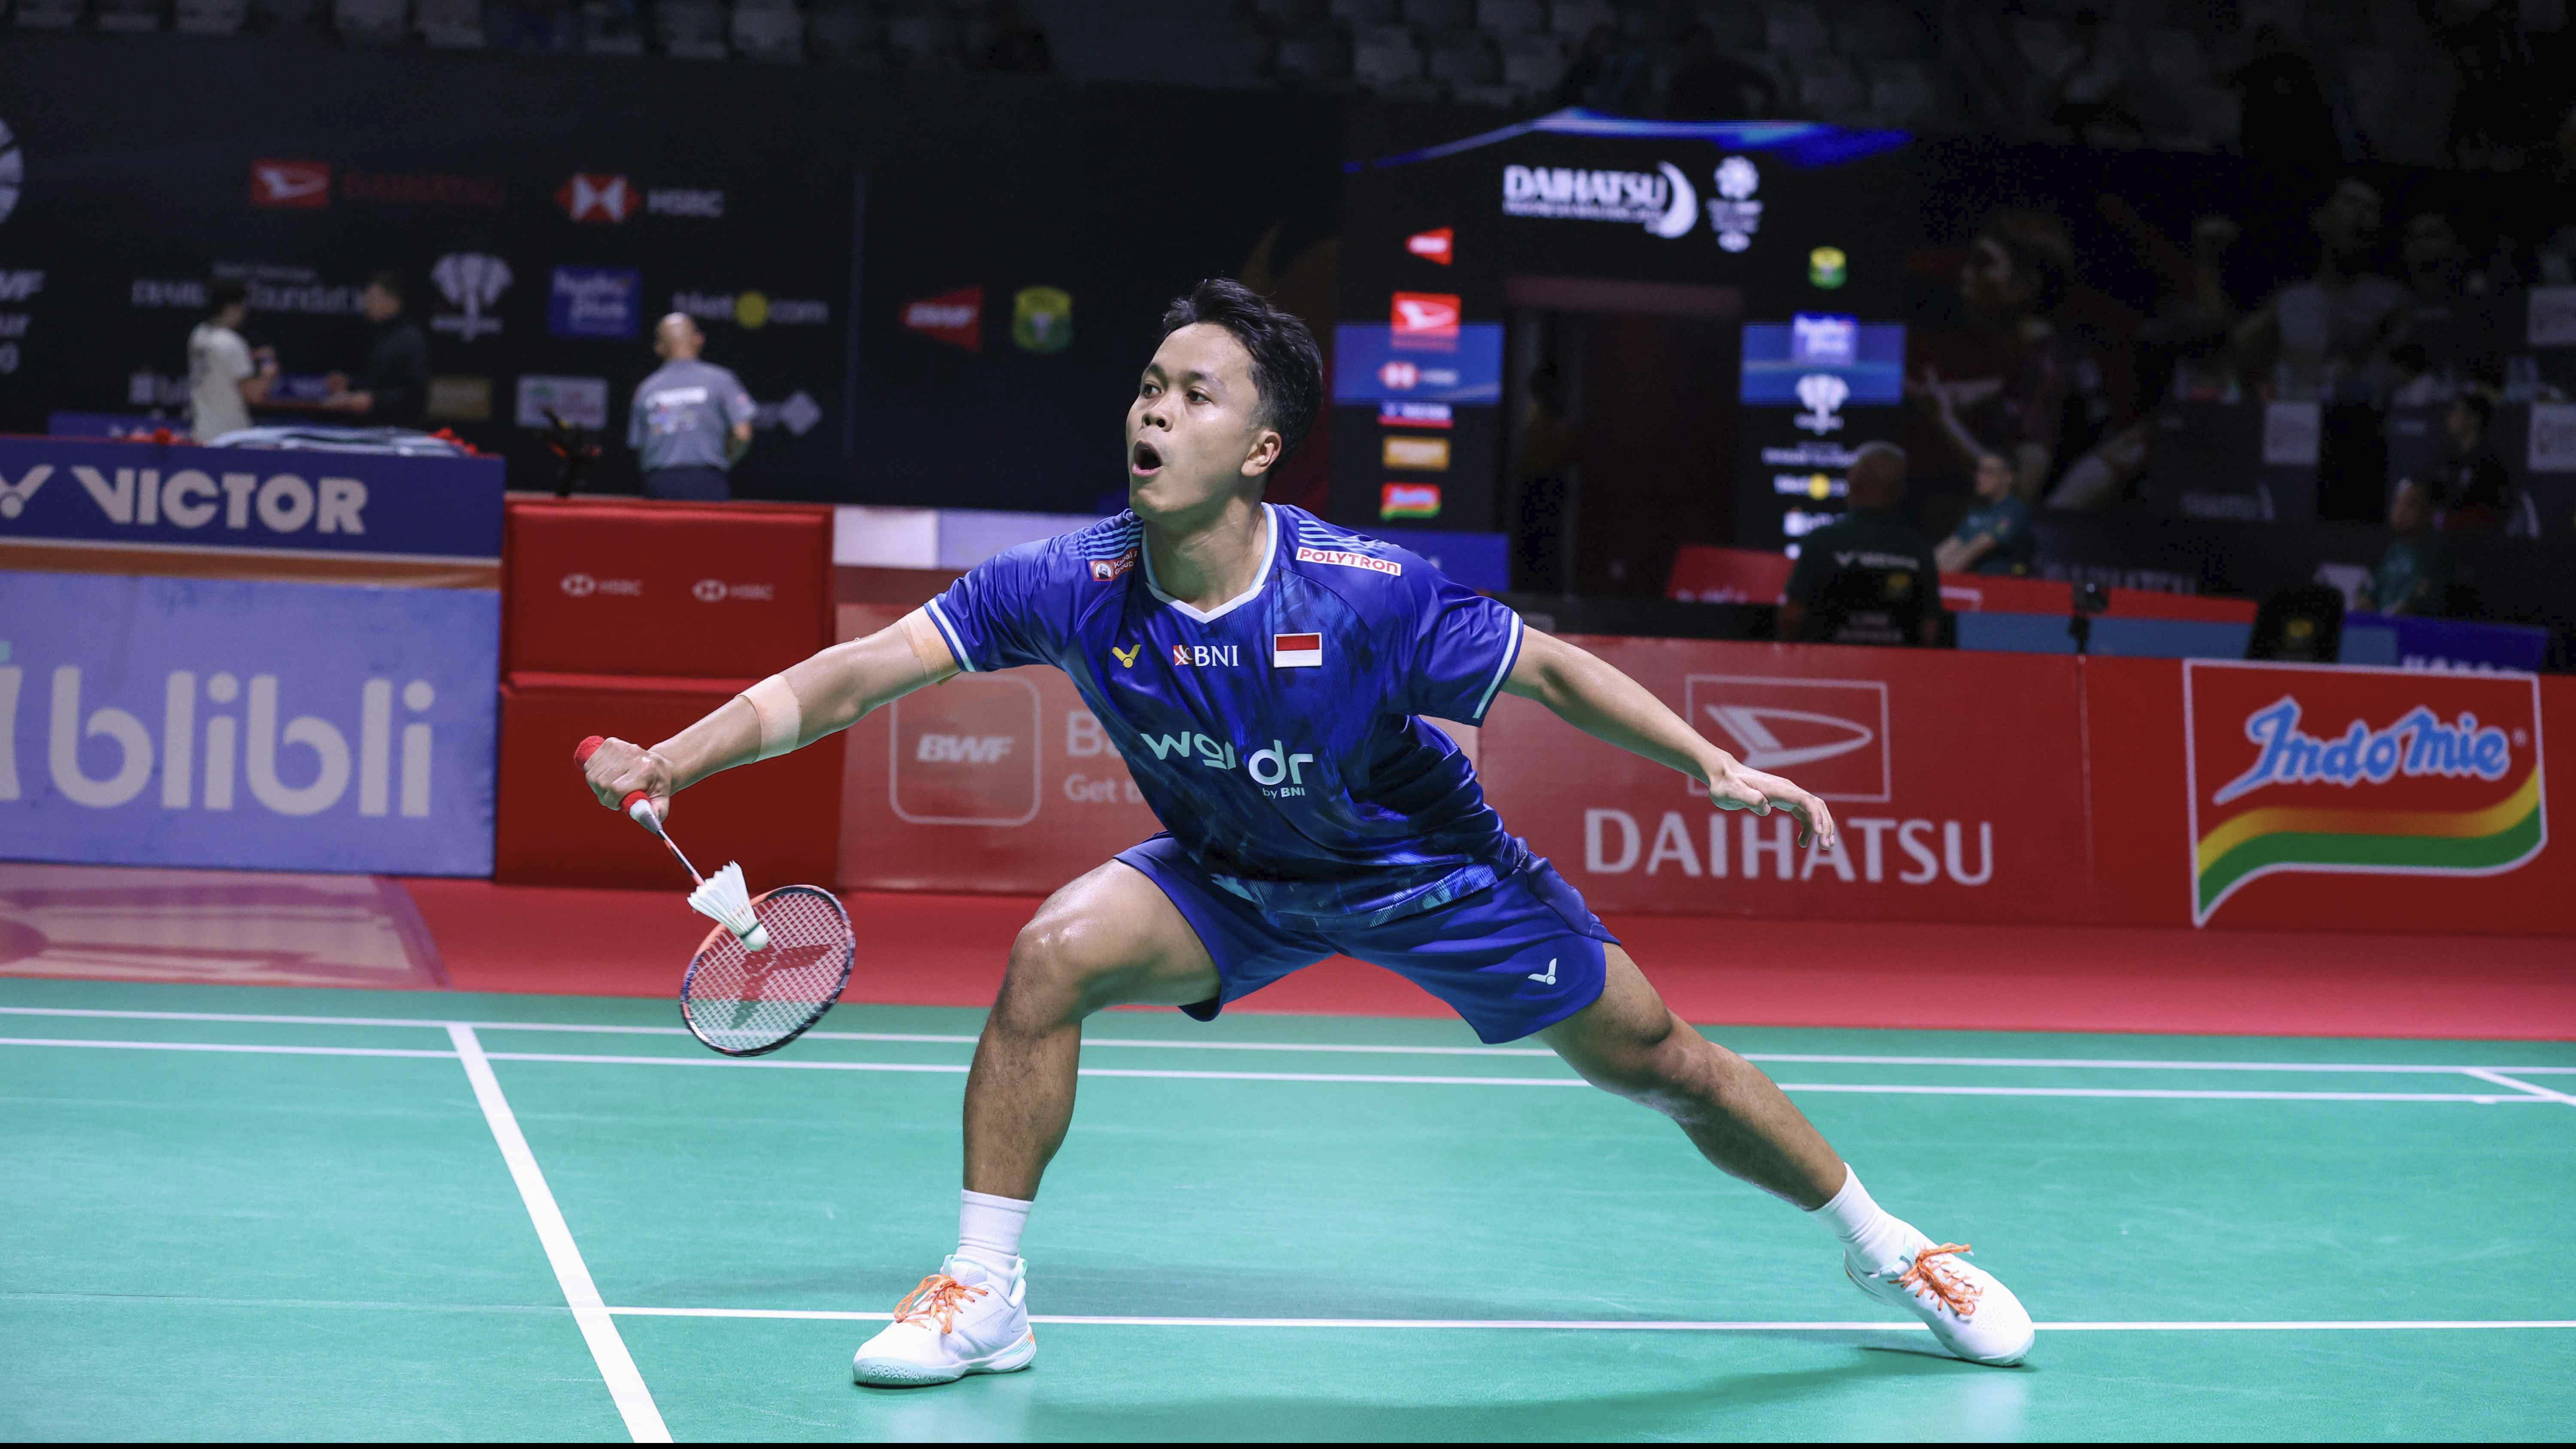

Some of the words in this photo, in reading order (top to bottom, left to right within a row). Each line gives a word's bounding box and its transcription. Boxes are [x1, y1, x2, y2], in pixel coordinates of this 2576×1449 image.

[1503, 164, 1668, 205] DAIHATSU
[70, 465, 368, 535] VICTOR
[1300, 549, 1398, 574] POLYTRON
[1194, 645, 1239, 667] BNI
[49, 665, 434, 817] blibli
[916, 732, 1014, 764] BWF
[1262, 787, 1278, 799] by
[1584, 808, 1993, 887] DAIHATSU
